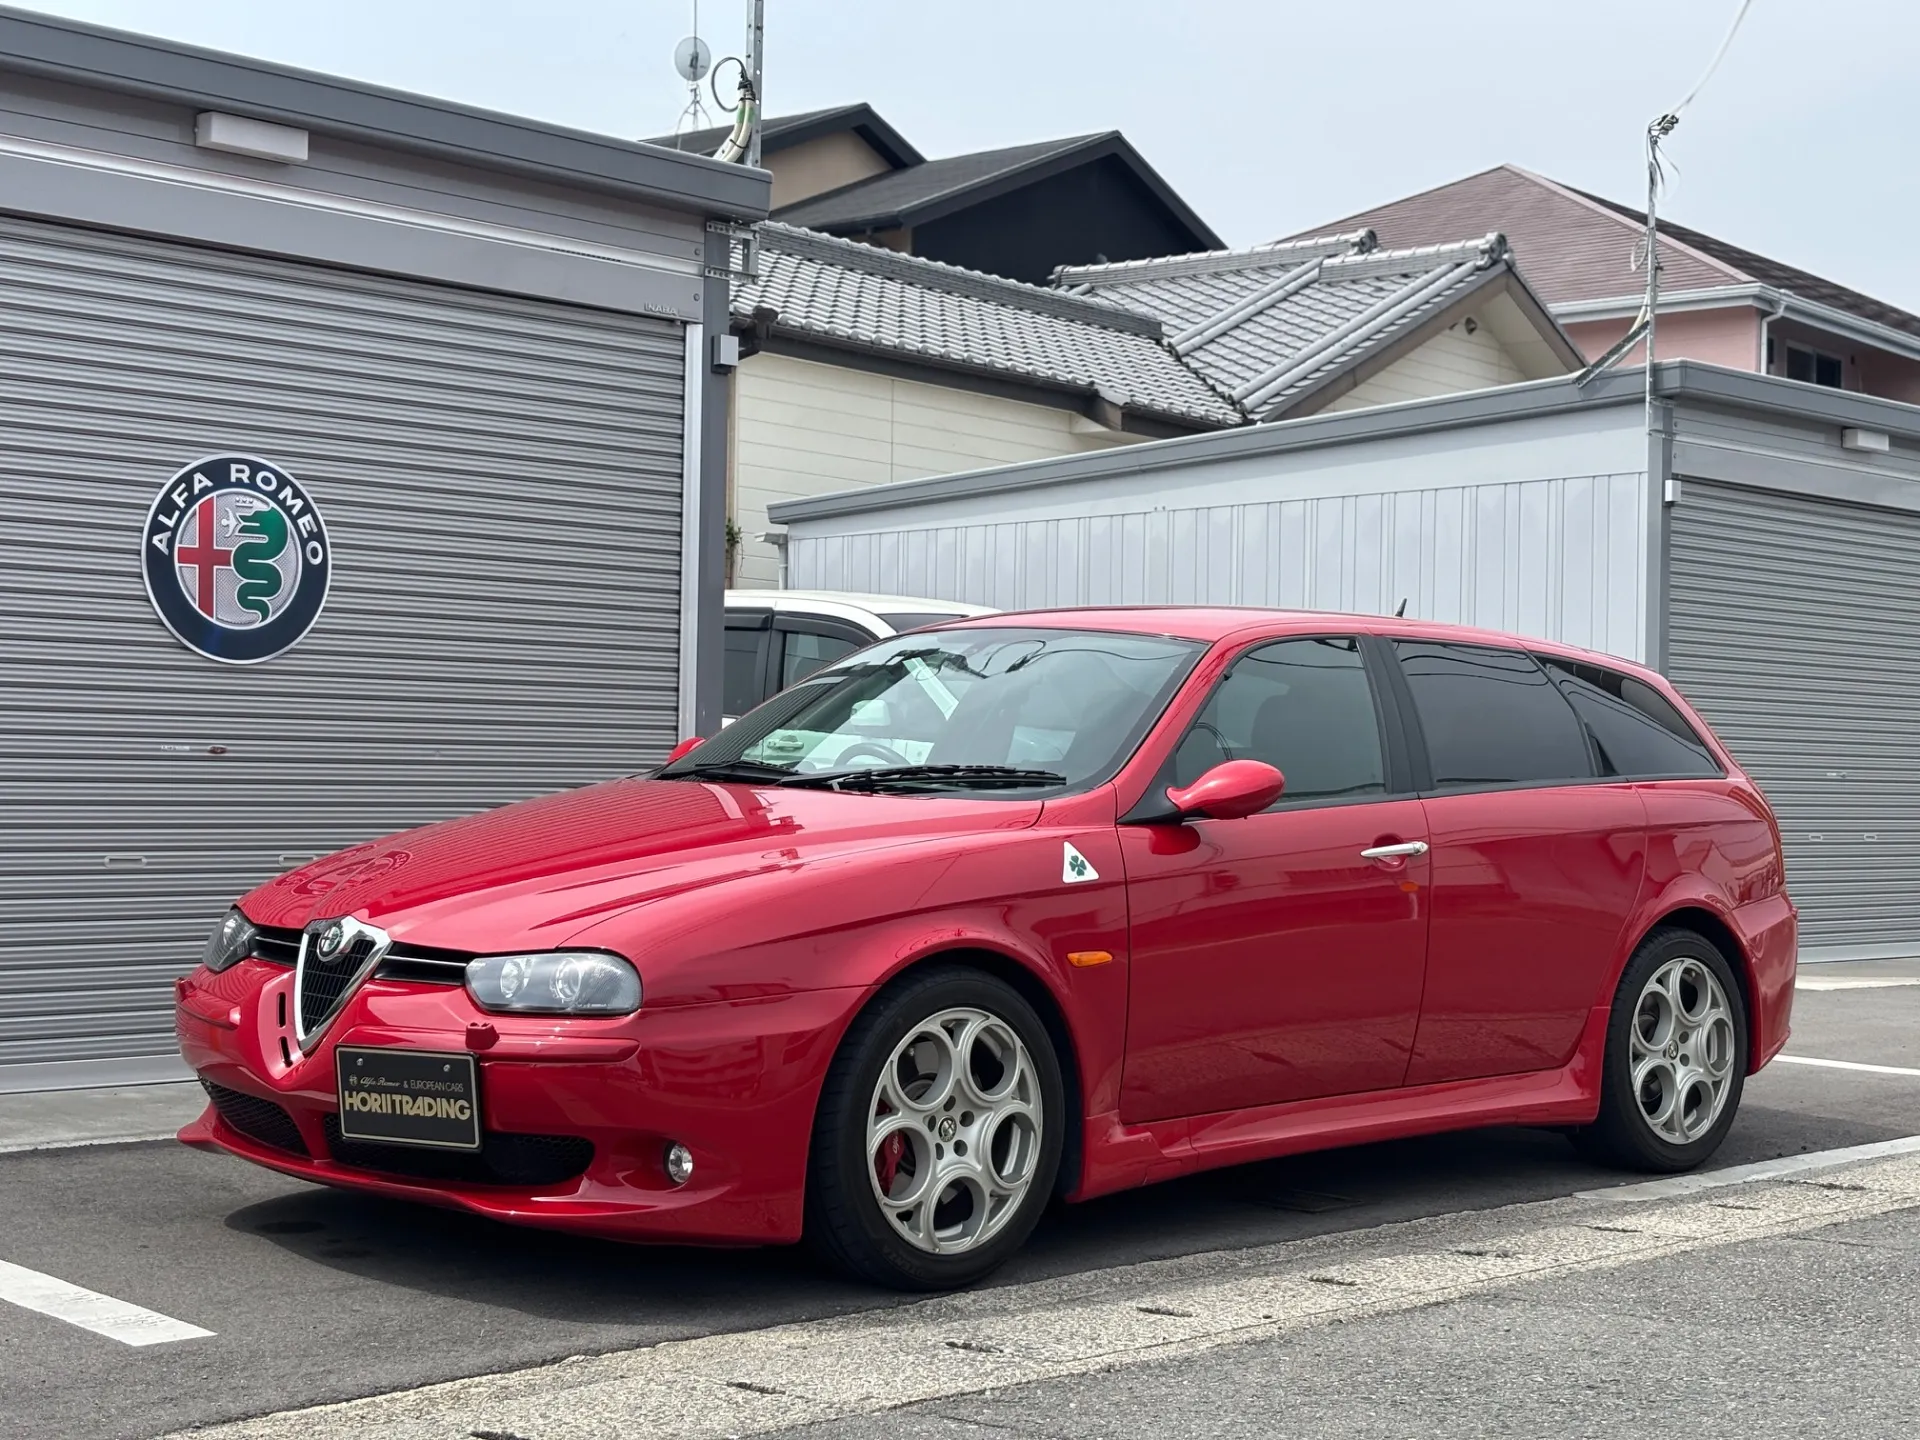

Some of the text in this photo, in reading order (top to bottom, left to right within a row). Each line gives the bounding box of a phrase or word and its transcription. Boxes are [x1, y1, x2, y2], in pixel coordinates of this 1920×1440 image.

[152, 463, 323, 566] ALFA ROMEO
[403, 1080, 409, 1088] &
[410, 1080, 445, 1091] EUROPEAN
[445, 1082, 464, 1093] CARS
